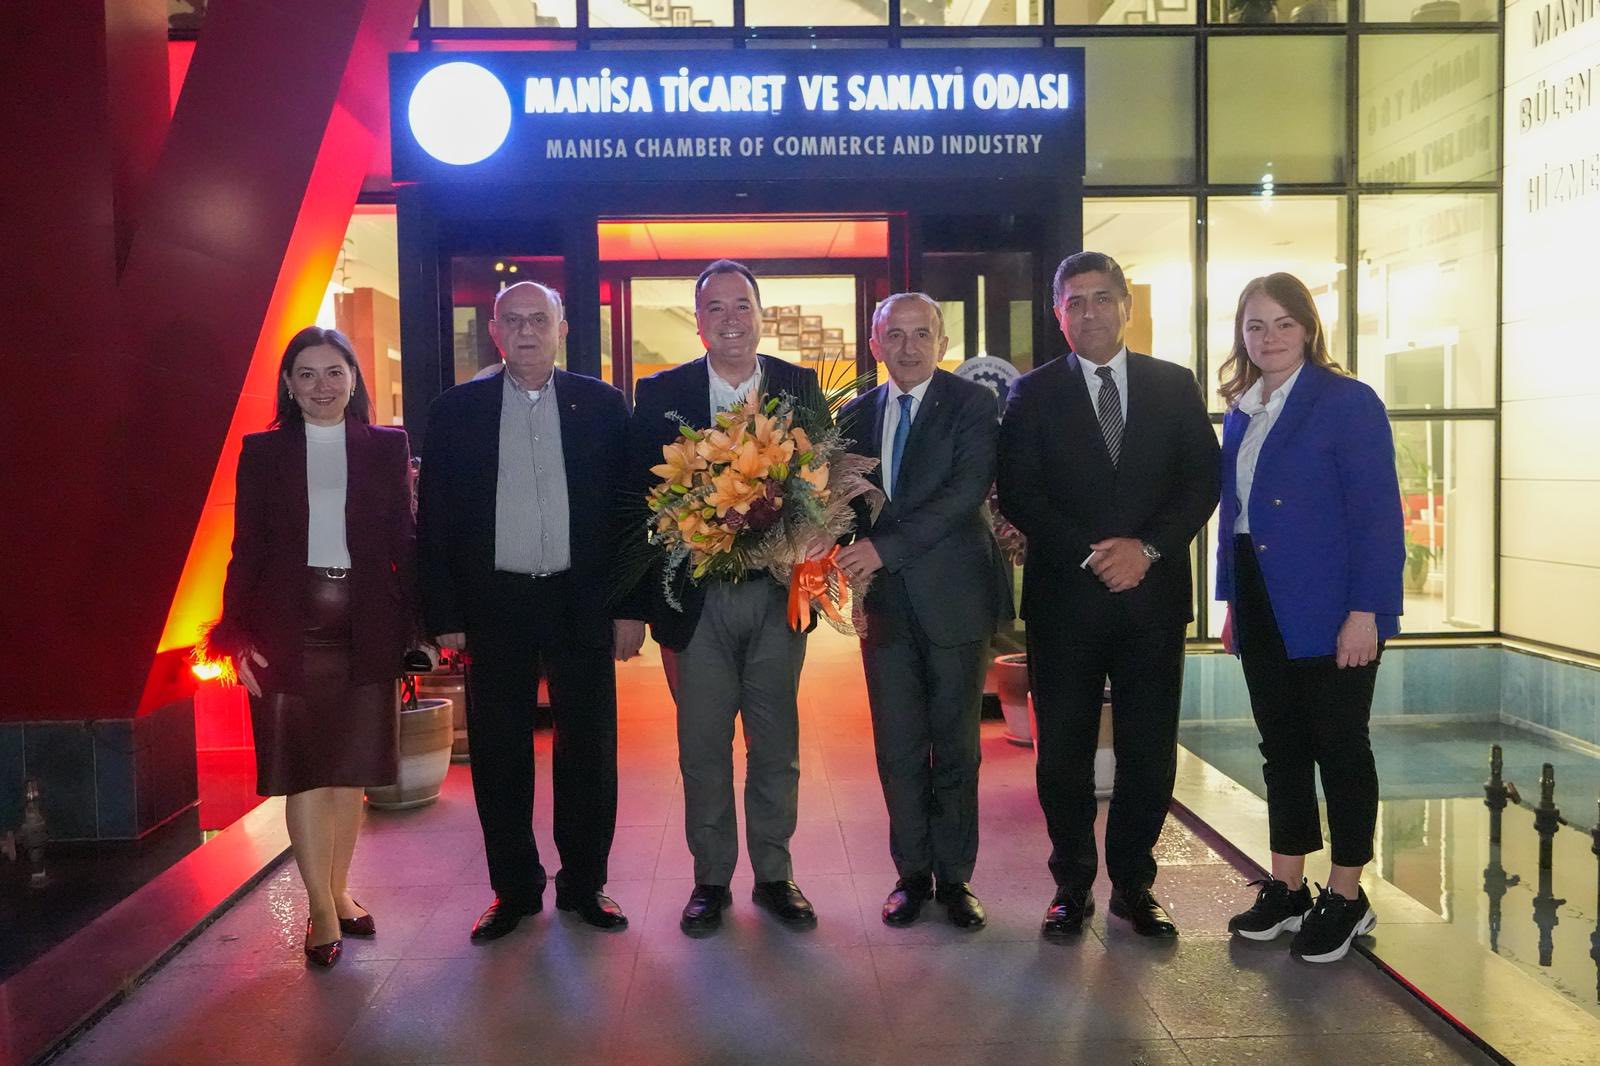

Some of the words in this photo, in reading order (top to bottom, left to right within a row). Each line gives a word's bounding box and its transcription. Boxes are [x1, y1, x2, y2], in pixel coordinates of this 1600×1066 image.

[1532, 0, 1600, 48] MAN
[524, 67, 653, 114] MANİSA
[659, 66, 787, 114] TİCARET
[798, 75, 839, 111] VE
[847, 66, 965, 111] SANAYİ
[972, 73, 1069, 110] ODASI
[1519, 63, 1600, 134] BÜLEN
[545, 138, 628, 159] MANISA
[634, 137, 732, 158] CHAMBER
[739, 136, 764, 157] OF
[773, 135, 886, 156] COMMERCE
[893, 135, 935, 155] AND
[941, 134, 1043, 155] INDUSTRY
